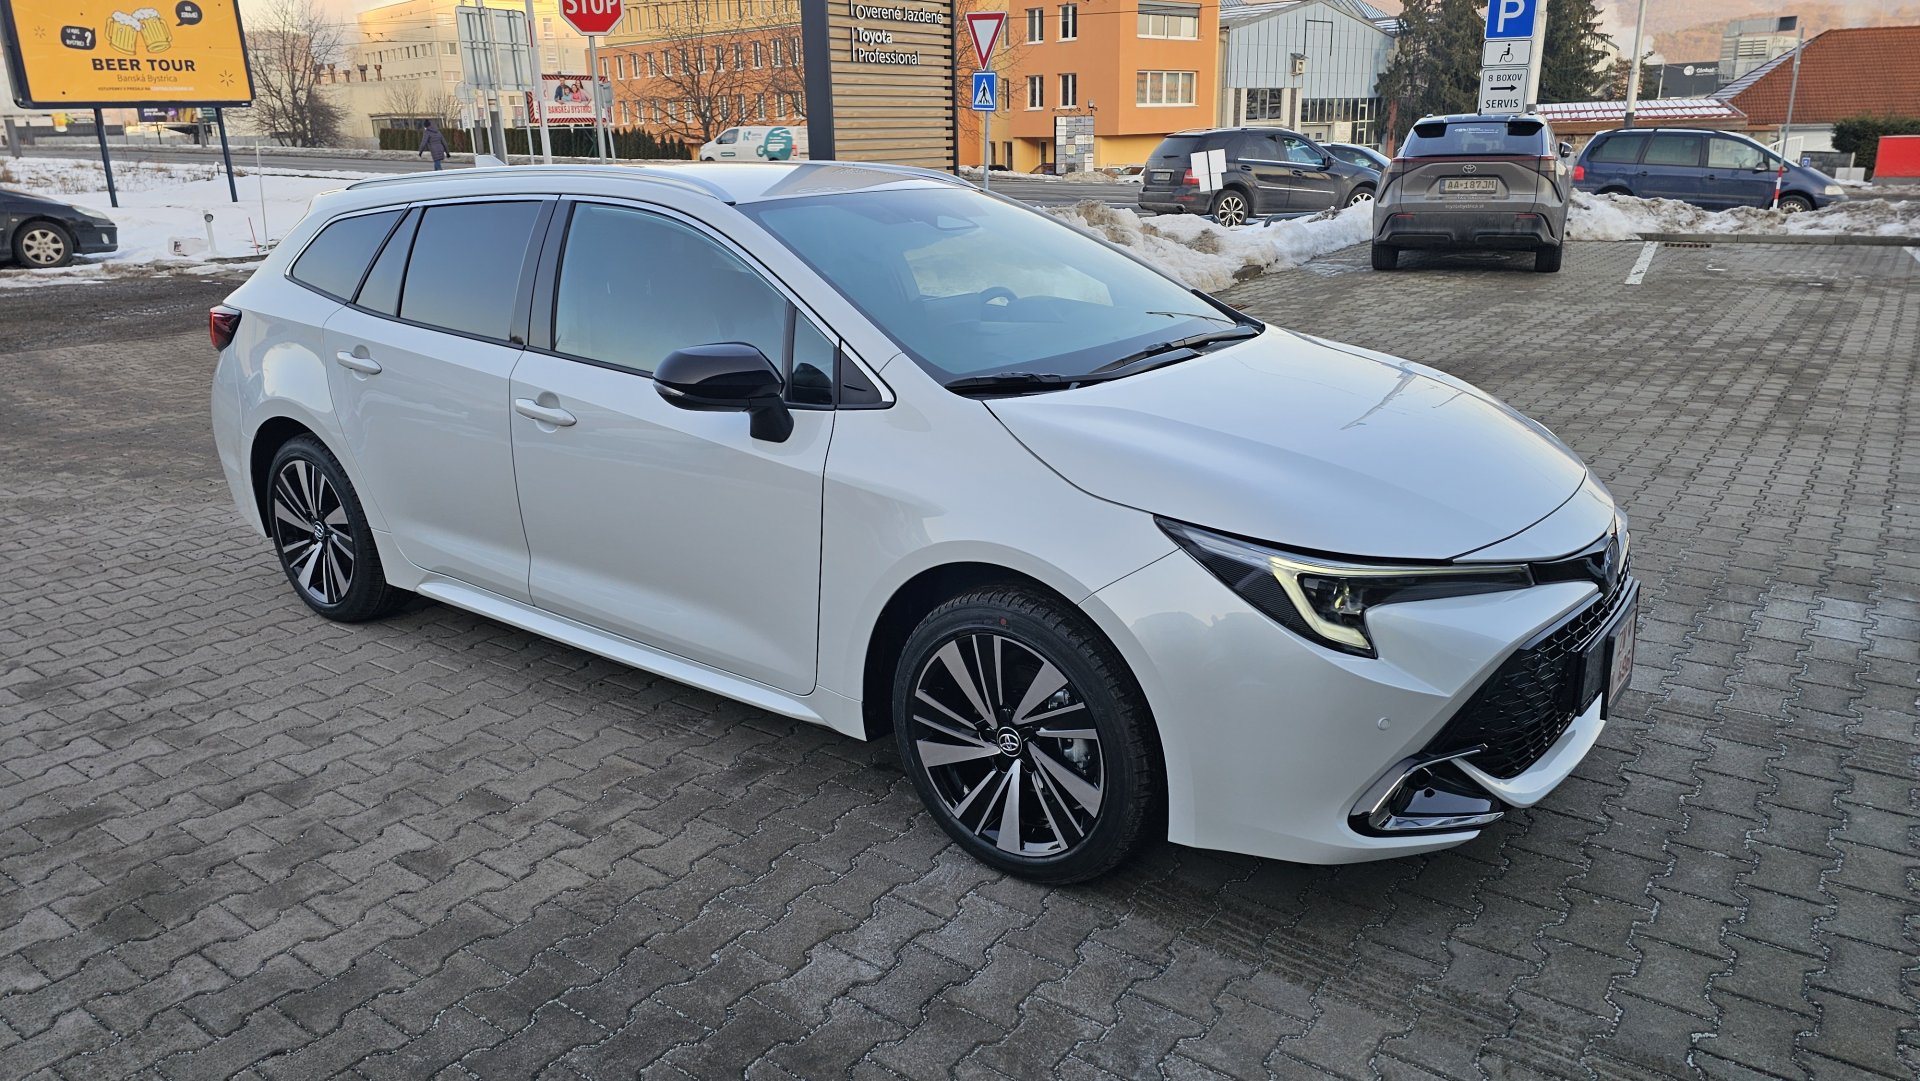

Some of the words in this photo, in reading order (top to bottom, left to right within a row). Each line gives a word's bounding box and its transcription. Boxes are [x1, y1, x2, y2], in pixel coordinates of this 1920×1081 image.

[856, 5, 901, 20] Overené
[903, 7, 943, 24] Jazdené
[1497, 0, 1525, 32] P
[857, 27, 892, 45] Toyota
[92, 58, 141, 71] BEER
[147, 59, 196, 72] TOUR
[859, 48, 920, 65] Professional
[117, 73, 146, 83] Banská
[147, 74, 178, 84] Bystrica
[1485, 99, 1519, 109] SERVIS
